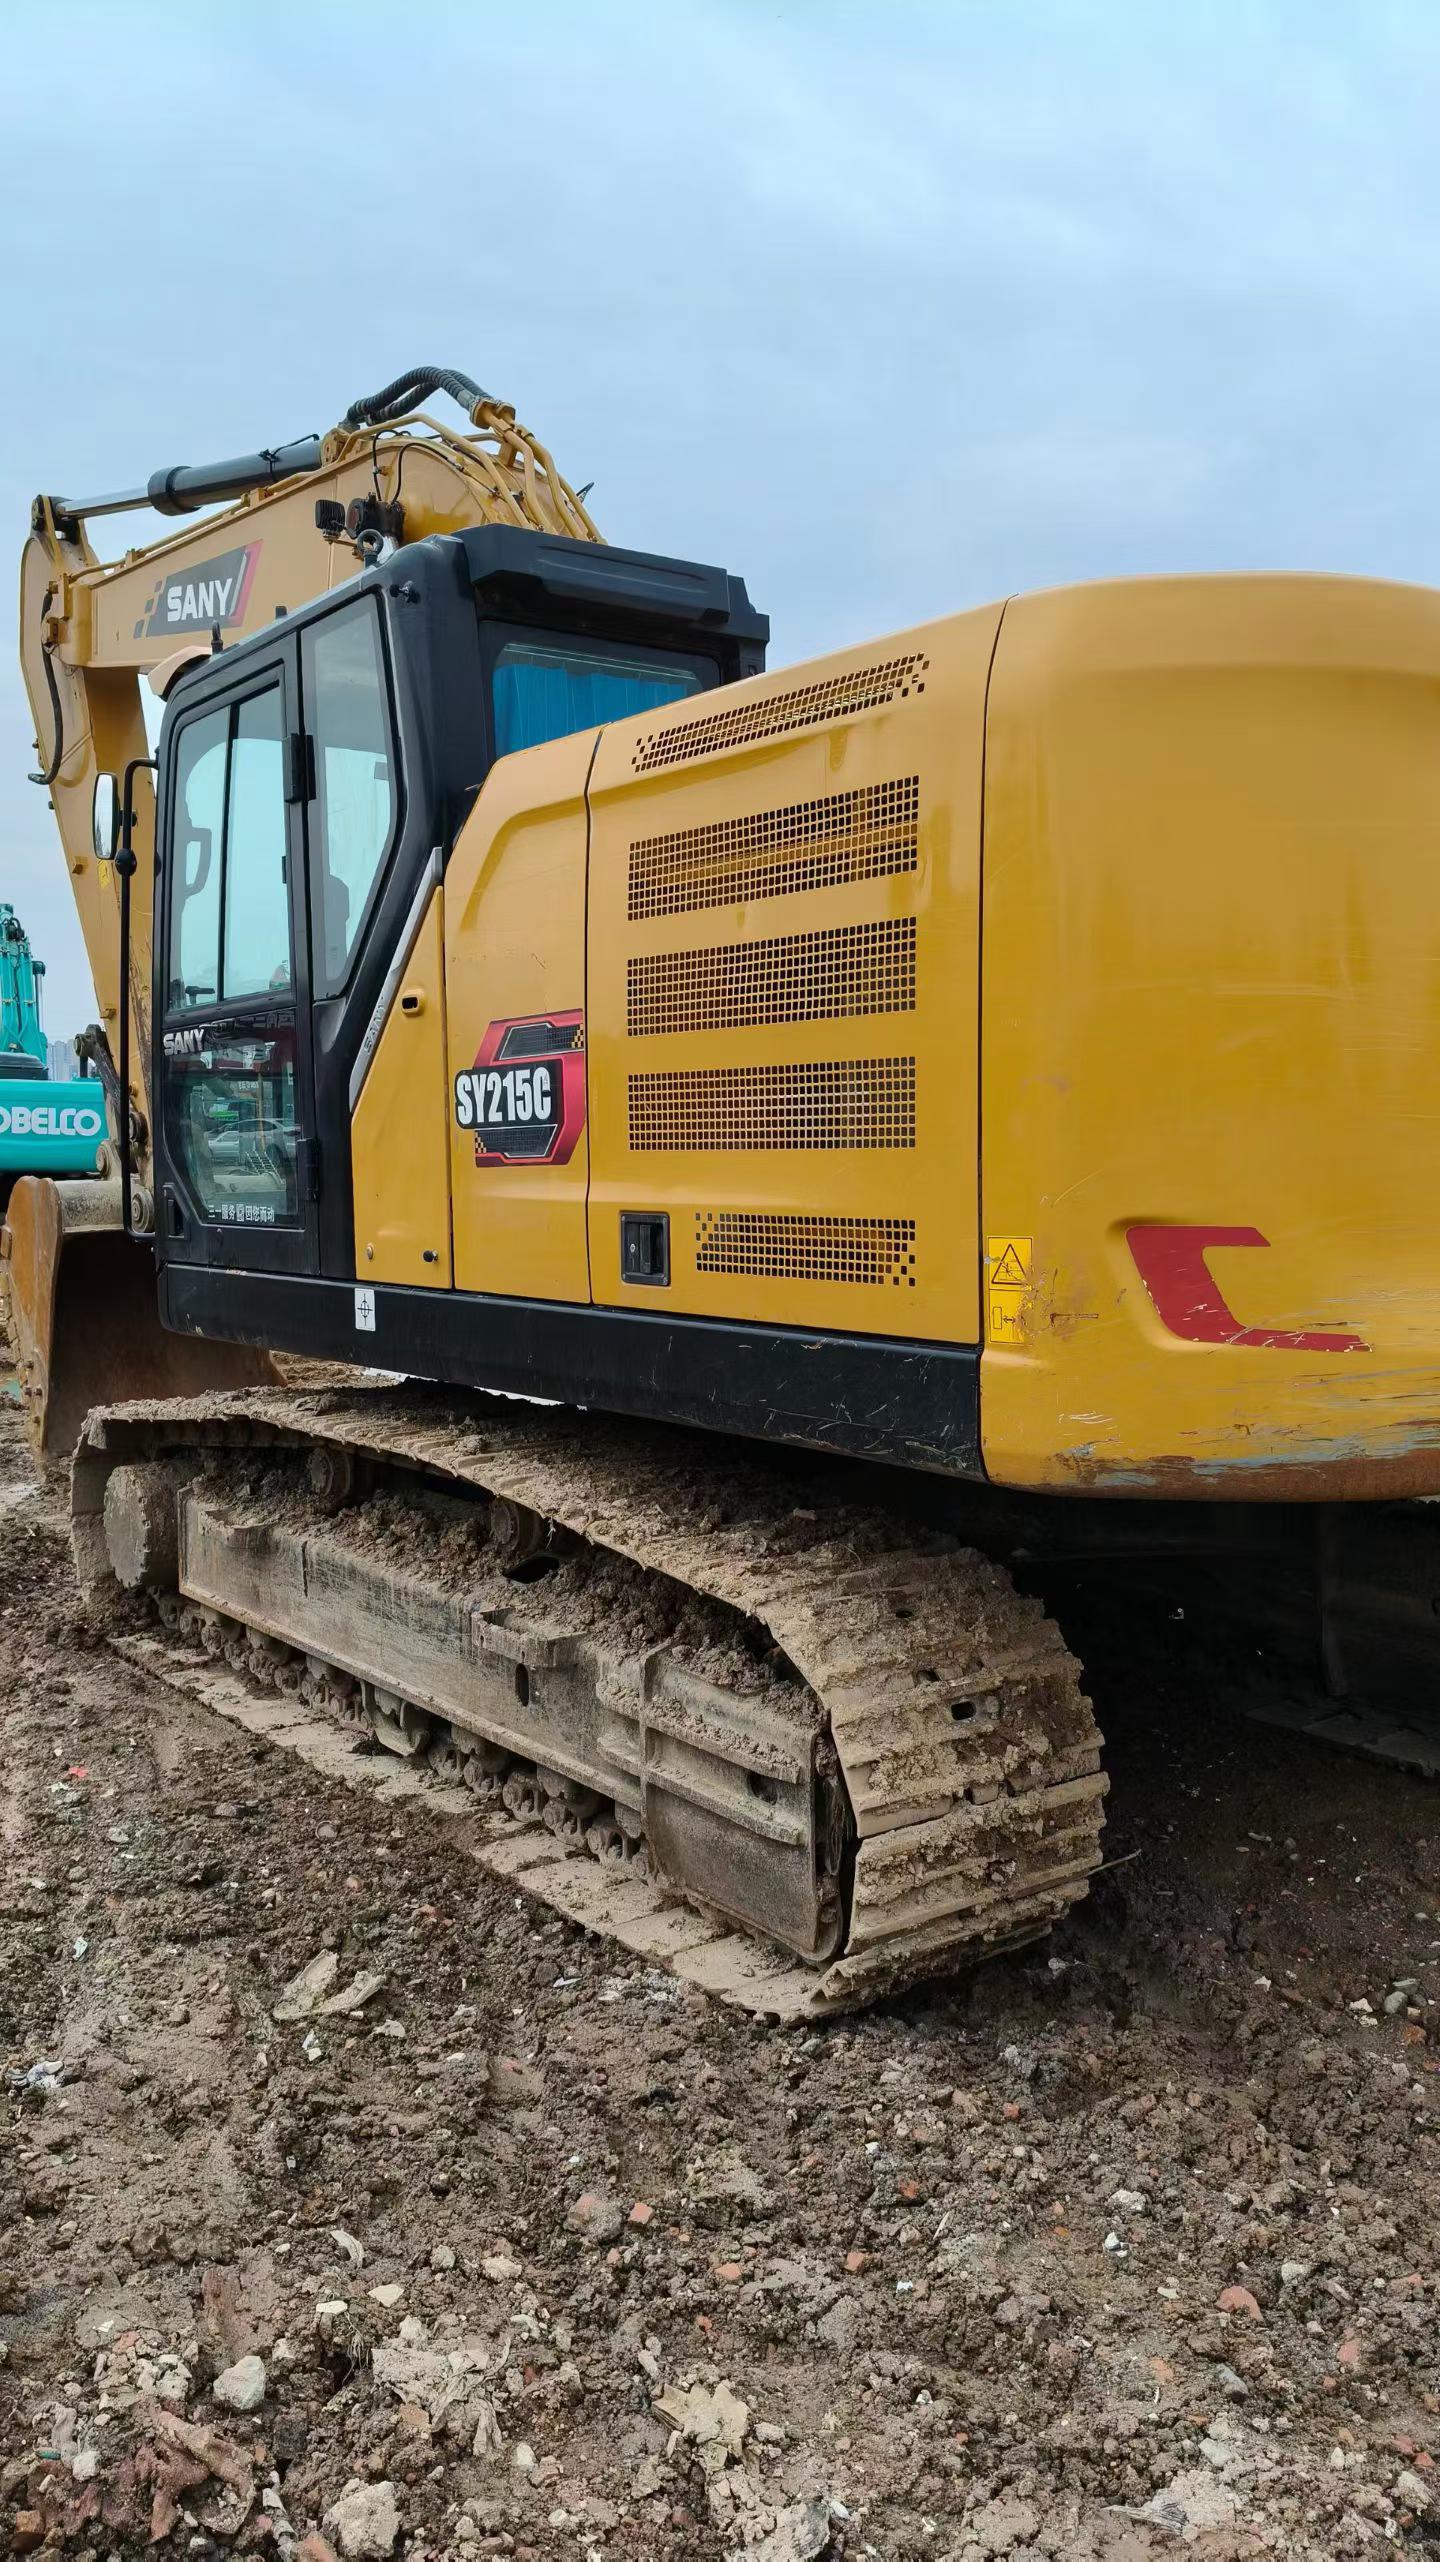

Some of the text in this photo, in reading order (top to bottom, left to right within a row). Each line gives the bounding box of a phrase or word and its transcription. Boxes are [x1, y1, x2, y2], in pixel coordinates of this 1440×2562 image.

[167, 578, 233, 622] SANY
[163, 1028, 205, 1056] SANY
[456, 1066, 552, 1125] SY215C
